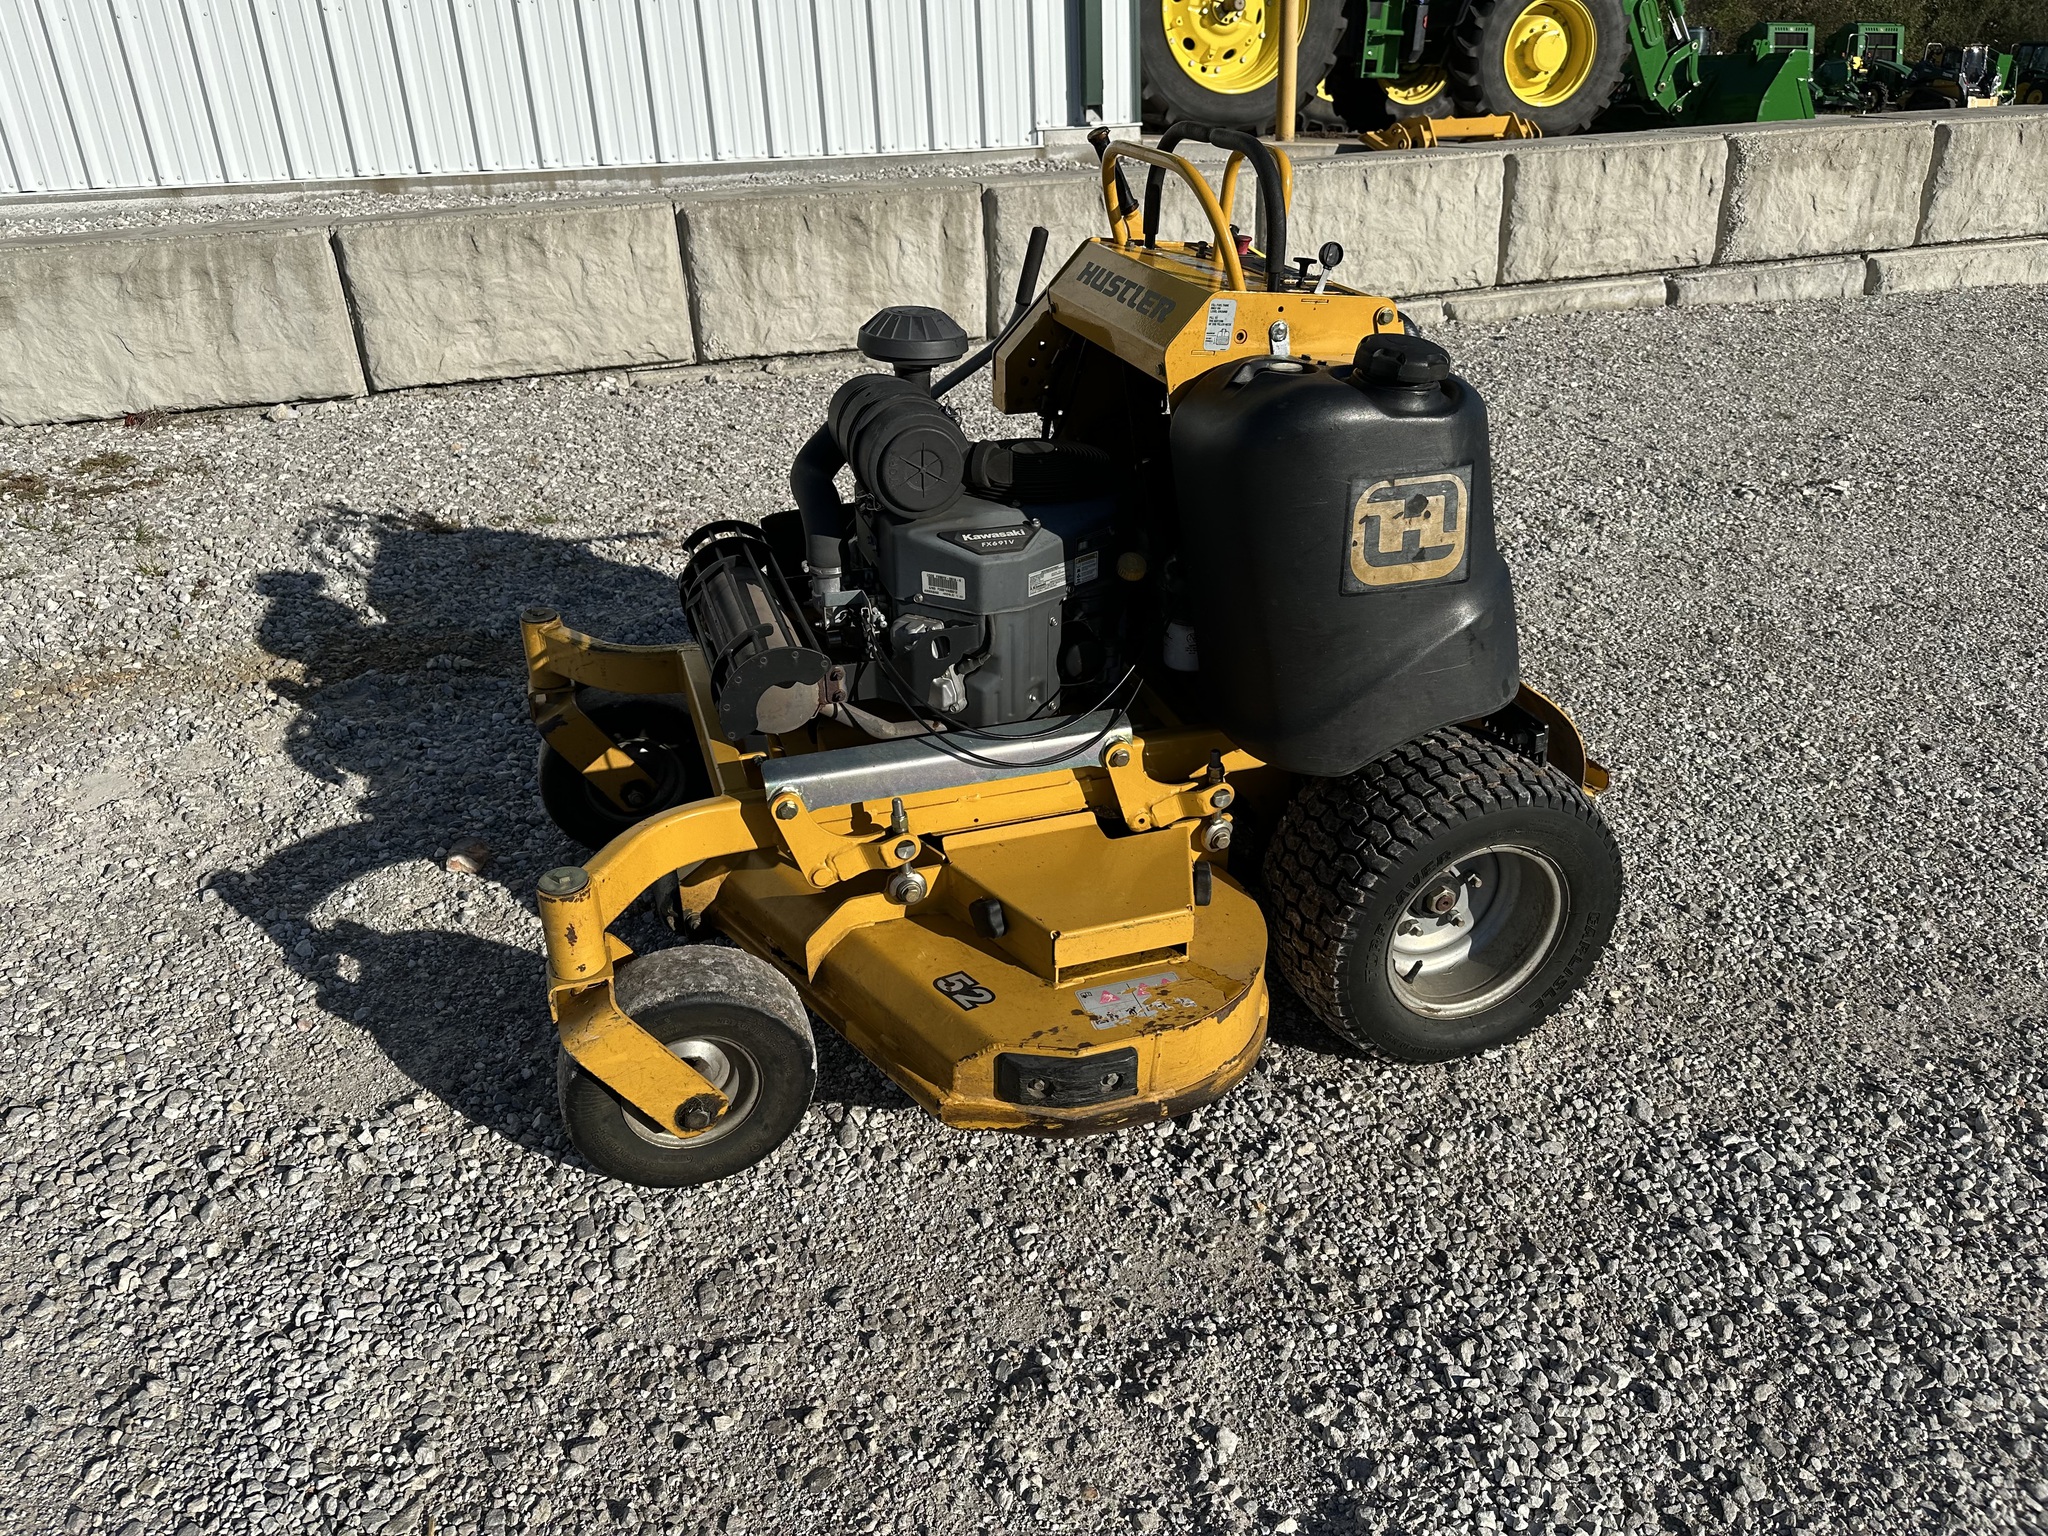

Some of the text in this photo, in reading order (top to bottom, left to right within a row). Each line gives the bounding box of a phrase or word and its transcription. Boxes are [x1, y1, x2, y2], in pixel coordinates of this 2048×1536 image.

[1076, 261, 1177, 323] HUSTLER
[962, 529, 1026, 541] Kawasaki
[981, 539, 1015, 547] FX691V
[934, 971, 995, 1010] 52
